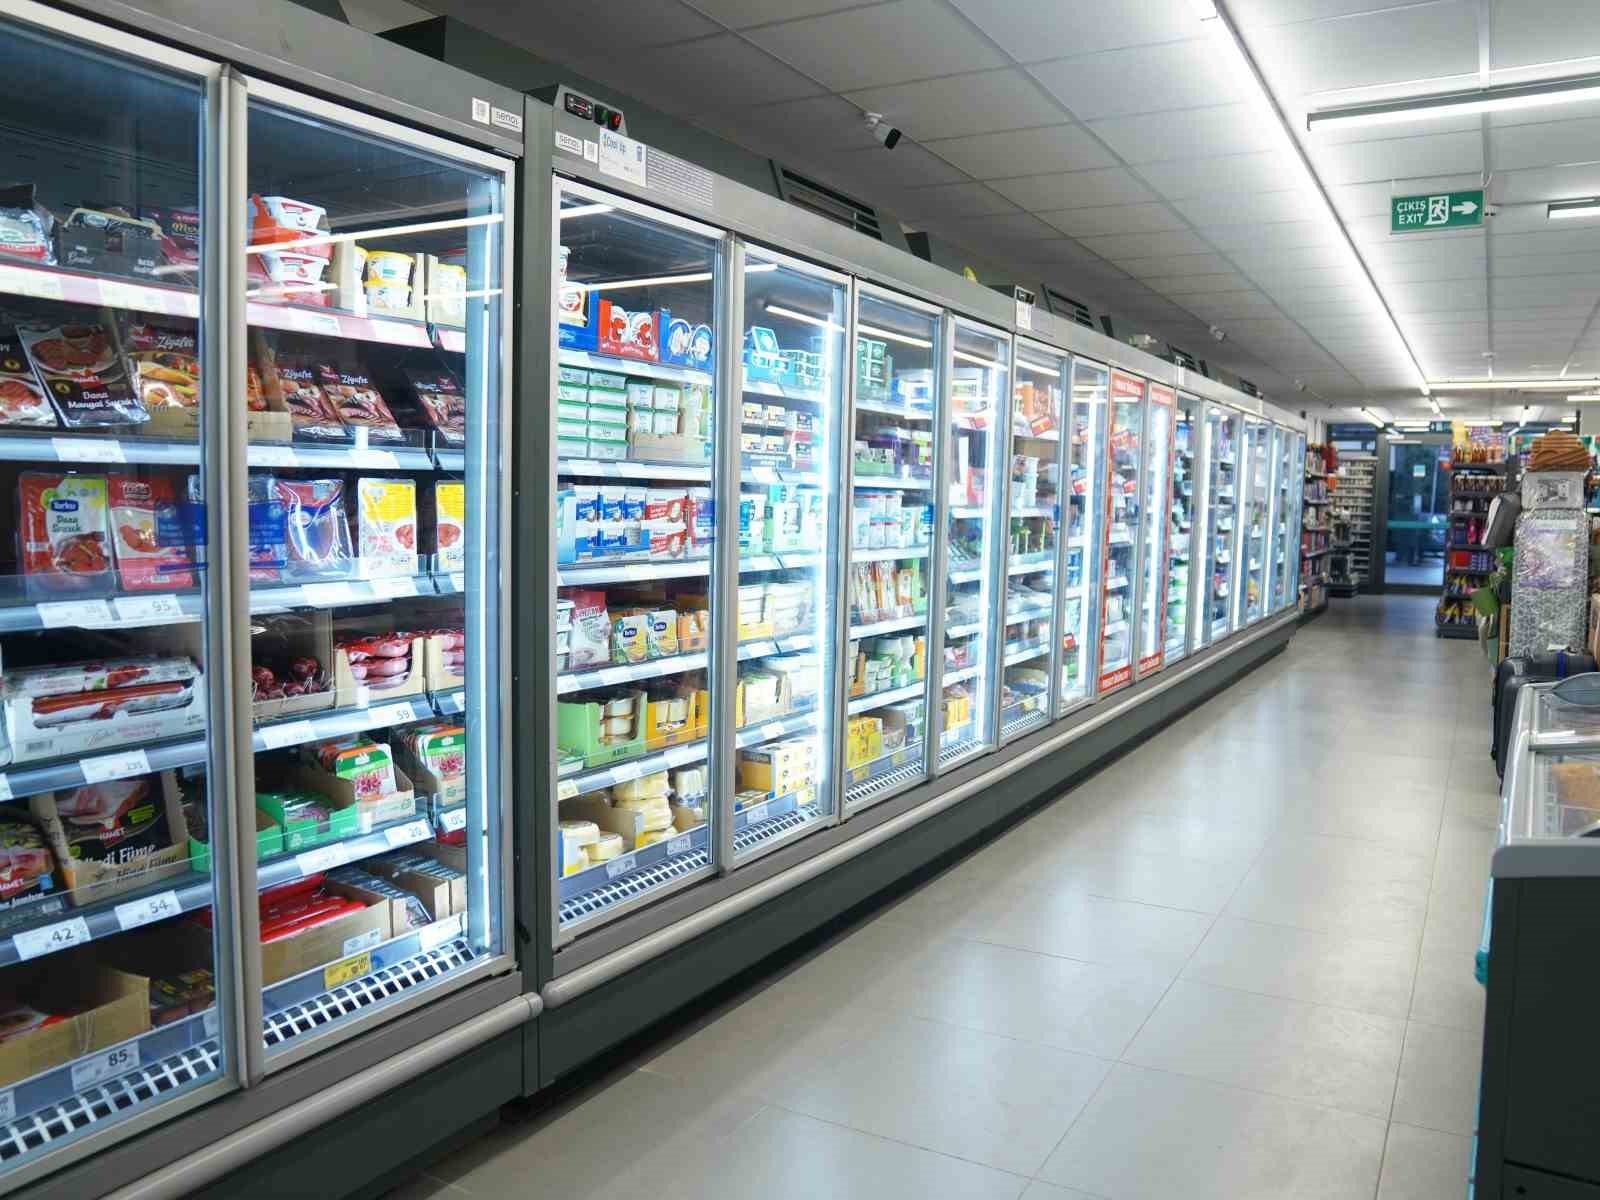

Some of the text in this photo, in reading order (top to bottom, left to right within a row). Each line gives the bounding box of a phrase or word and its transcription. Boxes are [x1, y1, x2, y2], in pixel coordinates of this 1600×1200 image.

[1399, 213, 1424, 225] EXIT
[83, 391, 108, 400] Dana
[52, 500, 78, 511] Torku
[149, 899, 169, 914] 54
[52, 927, 74, 943] 42
[108, 1049, 128, 1067] 85
